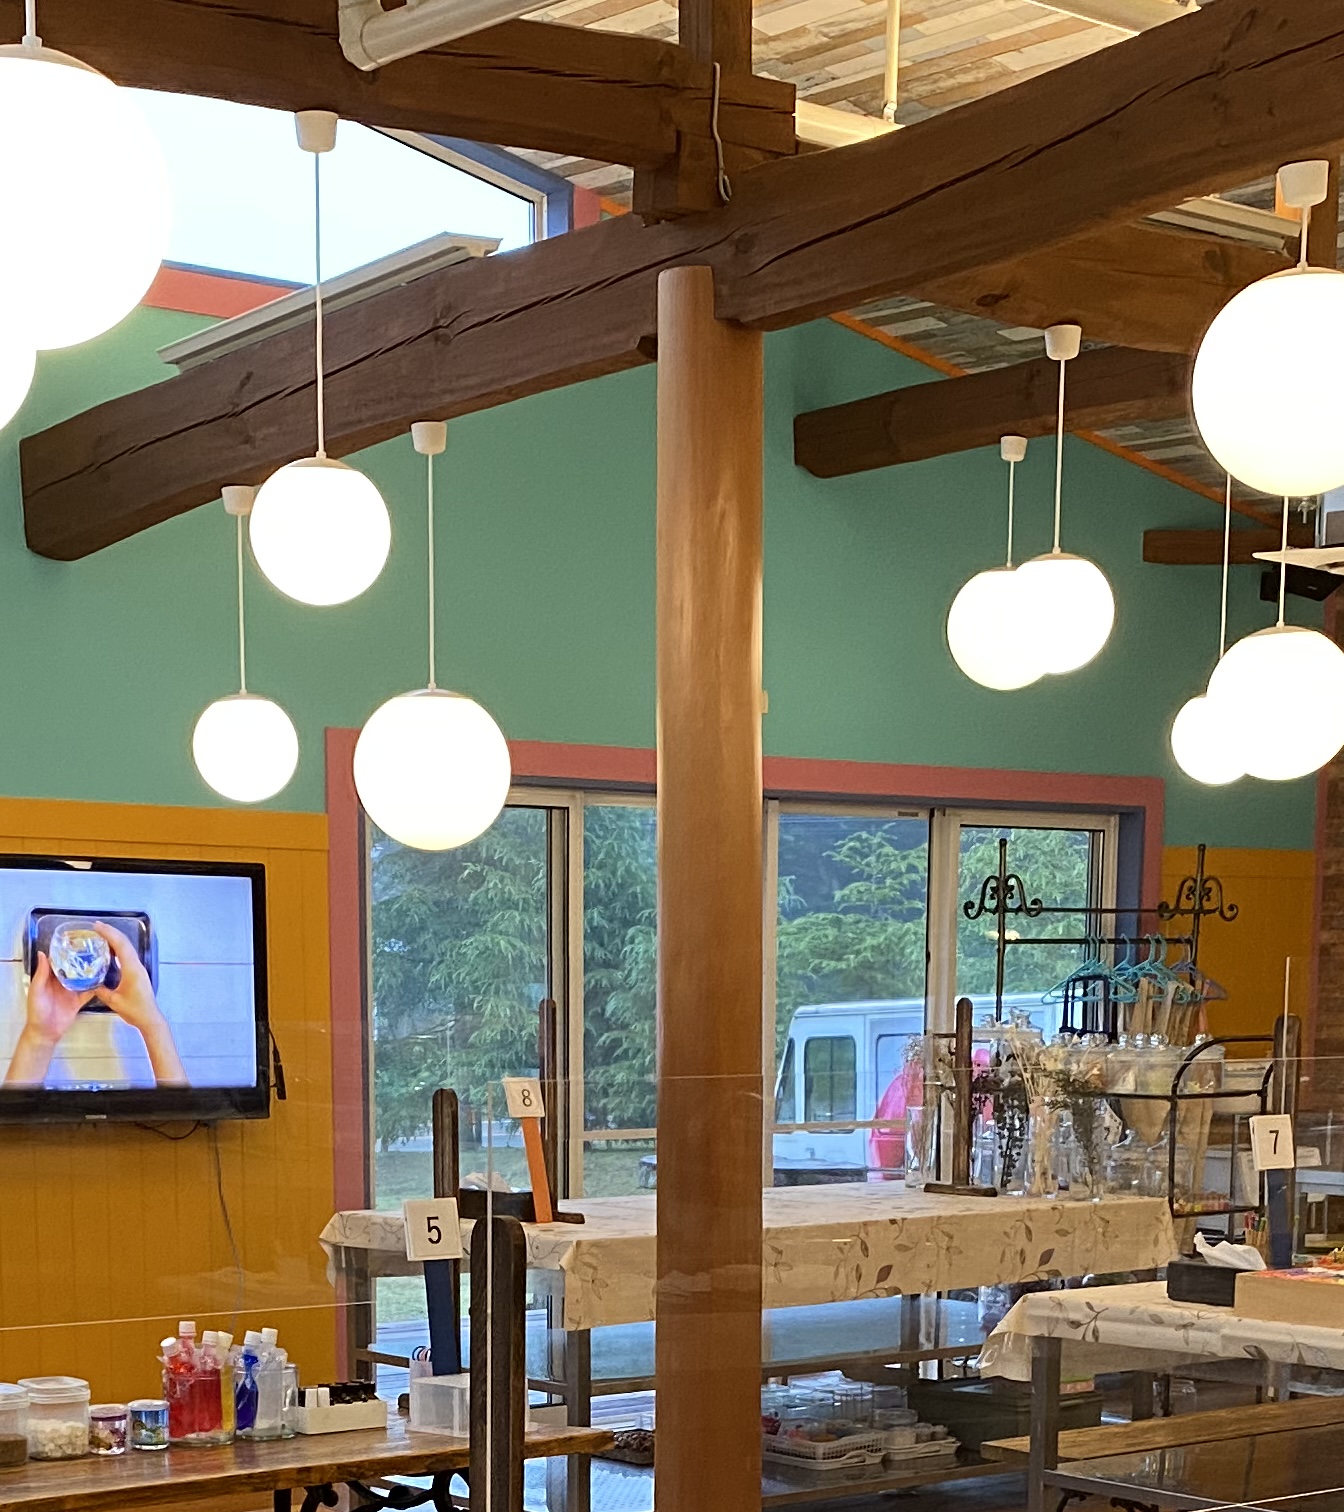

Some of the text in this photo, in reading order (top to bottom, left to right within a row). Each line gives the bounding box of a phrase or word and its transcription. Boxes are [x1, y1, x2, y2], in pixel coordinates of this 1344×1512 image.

[521, 1088, 533, 1107] 8
[1269, 1129, 1279, 1155] 7
[426, 1216, 442, 1245] 5
